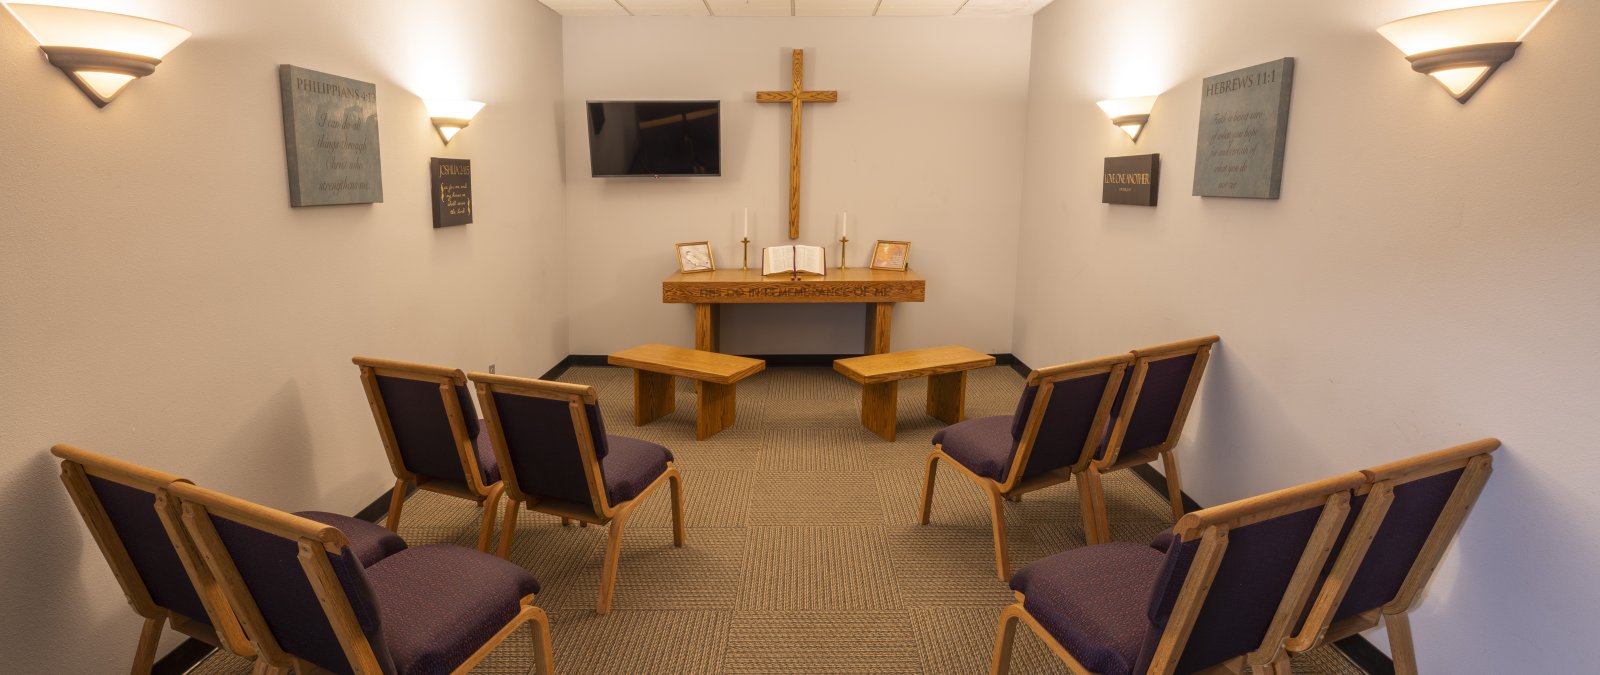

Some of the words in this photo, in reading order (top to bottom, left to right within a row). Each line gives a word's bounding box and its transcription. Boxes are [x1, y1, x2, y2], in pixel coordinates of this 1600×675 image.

[297, 78, 360, 99] PHILIPPIANS
[1206, 77, 1254, 97] HEBREWS
[1256, 69, 1276, 87] 11:1
[327, 120, 340, 129] can
[341, 115, 351, 129] do
[317, 132, 340, 153] things
[341, 135, 368, 154] through
[440, 165, 459, 177] JOSHUA
[1104, 173, 1116, 184] LOVE
[1115, 173, 1126, 184] ONE
[1126, 173, 1150, 185] ANOTHER
[748, 287, 761, 298] IN
[854, 287, 870, 297] OF
